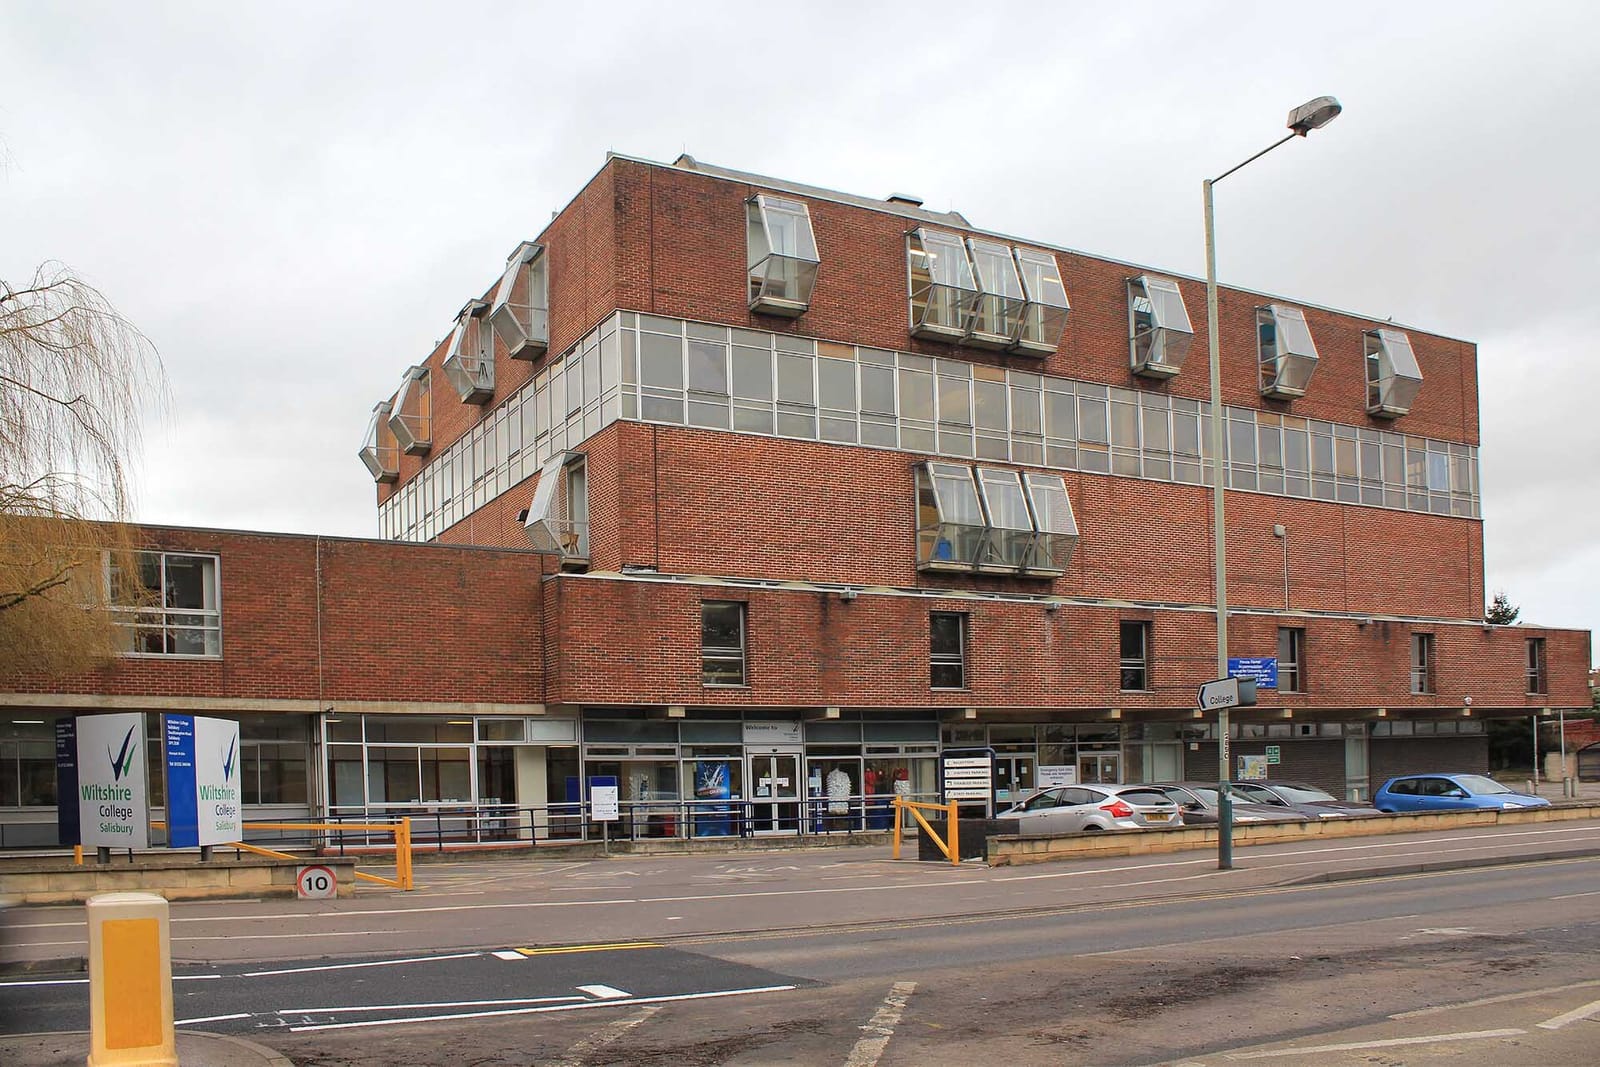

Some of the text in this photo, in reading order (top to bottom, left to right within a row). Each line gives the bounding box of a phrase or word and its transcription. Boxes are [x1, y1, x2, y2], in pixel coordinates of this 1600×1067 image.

[1209, 695, 1234, 705] College
[81, 784, 132, 801] Wiltshire
[199, 784, 235, 801] Wiltshire
[99, 804, 133, 821] College
[215, 804, 236, 818] College
[99, 822, 134, 836] Salisbury
[216, 821, 236, 832] Salisbury
[306, 877, 328, 890] 10
